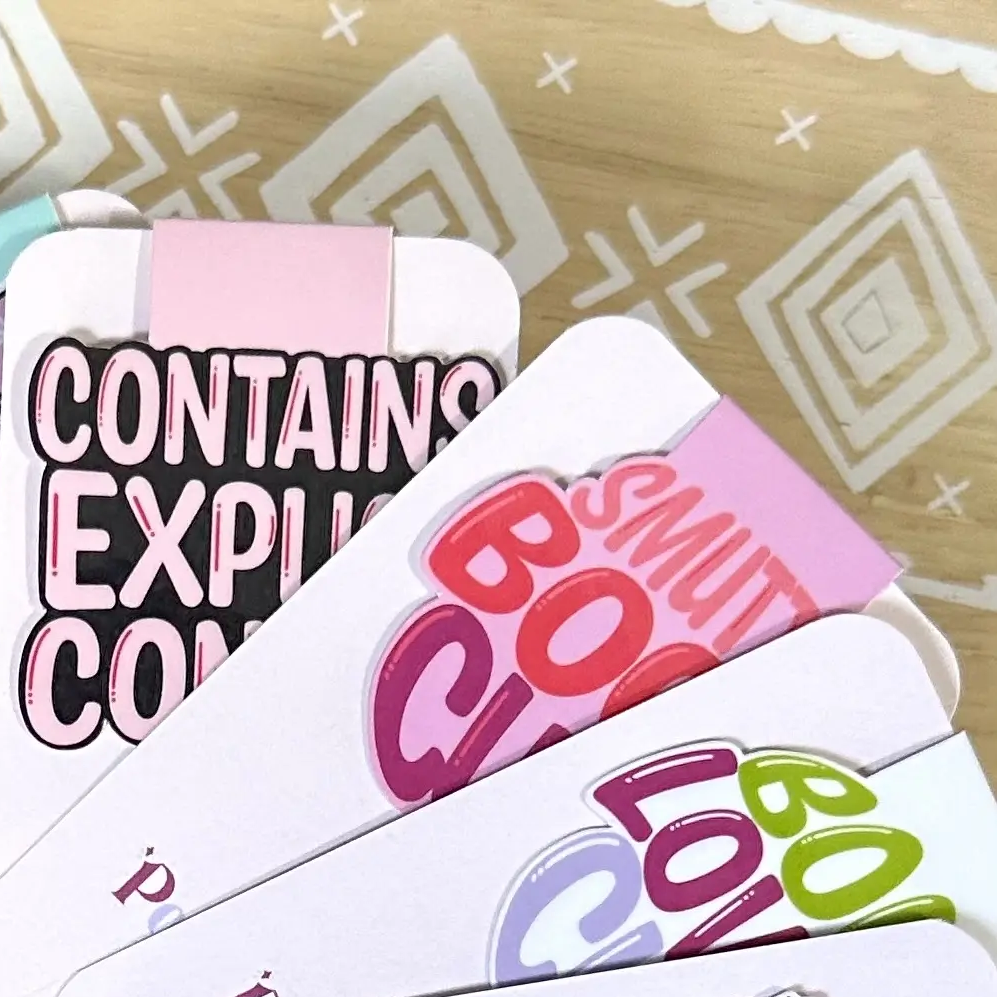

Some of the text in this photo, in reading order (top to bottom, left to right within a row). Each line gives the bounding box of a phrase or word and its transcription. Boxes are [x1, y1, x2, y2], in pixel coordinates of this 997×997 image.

[35, 345, 497, 473] CONTAINS
[570, 460, 821, 653] SMUT
[374, 604, 572, 802] CL
[739, 755, 956, 930] BO
